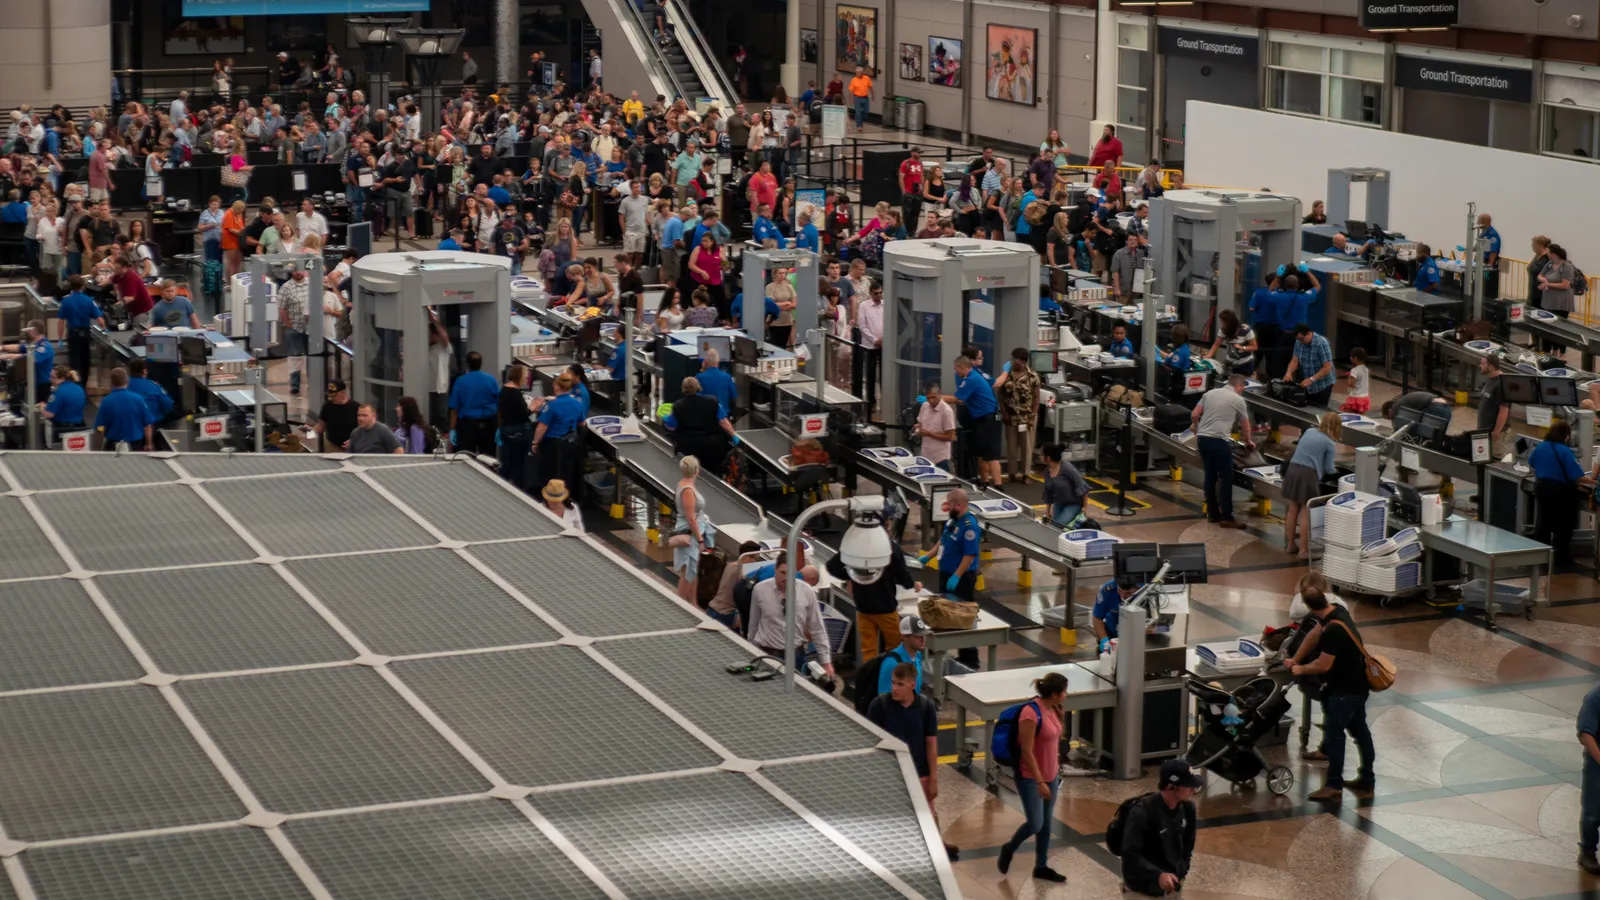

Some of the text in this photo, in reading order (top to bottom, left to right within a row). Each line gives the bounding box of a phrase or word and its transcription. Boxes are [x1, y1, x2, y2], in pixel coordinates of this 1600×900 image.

[1368, 4, 1454, 14] Ground Transportation
[1177, 37, 1243, 55] Ground Transportation
[1420, 67, 1508, 88] Ground Transportation
[305, 259, 314, 270] 4
